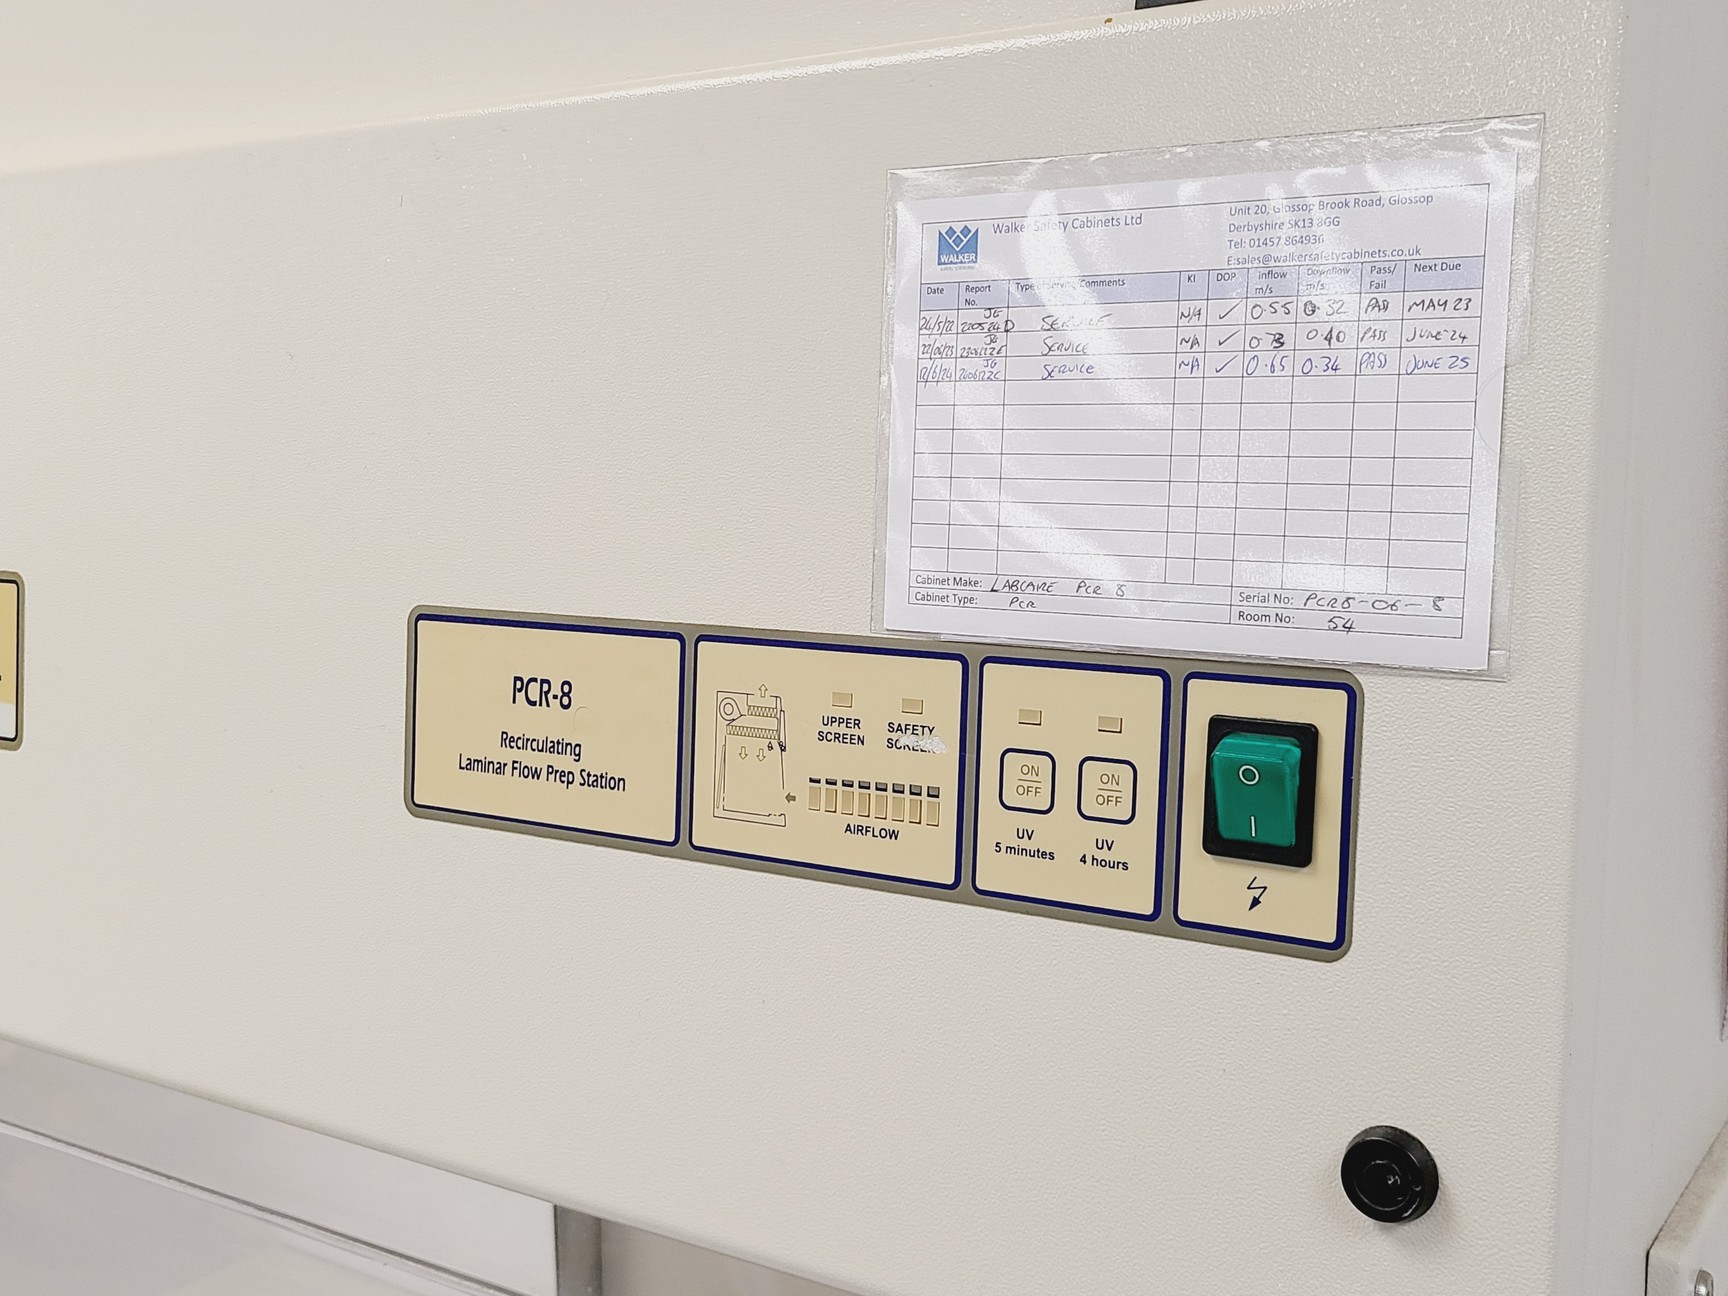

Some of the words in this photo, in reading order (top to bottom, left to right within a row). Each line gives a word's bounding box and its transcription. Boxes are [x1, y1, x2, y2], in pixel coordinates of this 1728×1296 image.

[1229, 205, 1251, 216] Unit
[1254, 204, 1270, 215] 20,
[1318, 197, 1350, 210] Brook
[1353, 195, 1385, 208] Road,
[1388, 194, 1434, 206] Glossop
[1071, 216, 1121, 229] Cabinets
[1124, 213, 1143, 226] Ltd
[1228, 220, 1285, 233] Derbyshire
[1287, 218, 1314, 229] SK13
[1227, 238, 1246, 249] Tel:
[1248, 236, 1281, 248] 01457
[1284, 234, 1325, 246] 864936
[940, 253, 976, 263] WALKER
[1370, 263, 1397, 275] Pass/
[1413, 262, 1438, 273] Next
[1440, 262, 1462, 271] Due
[1187, 274, 1196, 283] KI
[1216, 273, 1236, 282] DOP
[1369, 280, 1387, 289] Fail
[926, 286, 945, 295] Date
[965, 284, 991, 294] Report
[1015, 282, 1034, 292] Type
[1255, 284, 1273, 294] m/s
[964, 298, 978, 306] No.
[1407, 298, 1448, 313] MAY
[1453, 297, 1472, 311] 23
[1179, 306, 1202, 323] N/A
[1179, 334, 1200, 350] N/A
[1360, 326, 1387, 343] PASS
[1450, 329, 1468, 344] 24
[1178, 355, 1200, 375] N/A
[1360, 351, 1387, 374] PASS
[1448, 355, 1471, 370] 25
[915, 574, 951, 586] Cabinet
[952, 576, 983, 588] Make:
[914, 591, 950, 603] Cabinet
[952, 593, 978, 605] Type:
[1238, 591, 1272, 604] Serial
[1273, 593, 1294, 605] No:
[1238, 611, 1271, 623] Room
[1274, 613, 1295, 624] No:
[1327, 616, 1356, 635] 54
[512, 675, 573, 710] PCR-8
[822, 715, 861, 730] UPPER
[887, 721, 935, 736] SAFETY
[817, 730, 865, 746] SCREEN
[500, 731, 582, 763] Recirculating
[458, 753, 508, 776] Laminar
[511, 760, 543, 781] Flow
[546, 764, 575, 790] Prep
[579, 768, 626, 792] Station
[1020, 764, 1040, 777] ON
[1099, 773, 1121, 787] ON
[1016, 784, 1042, 798] OFF
[1095, 794, 1123, 807] OFF
[844, 823, 900, 841] AIRFLOW
[1016, 827, 1035, 841] UV
[994, 842, 1002, 853] 5
[1005, 844, 1056, 861] minutes
[1095, 838, 1115, 852] UV
[1079, 854, 1087, 866] 4
[1091, 855, 1129, 871] hours
